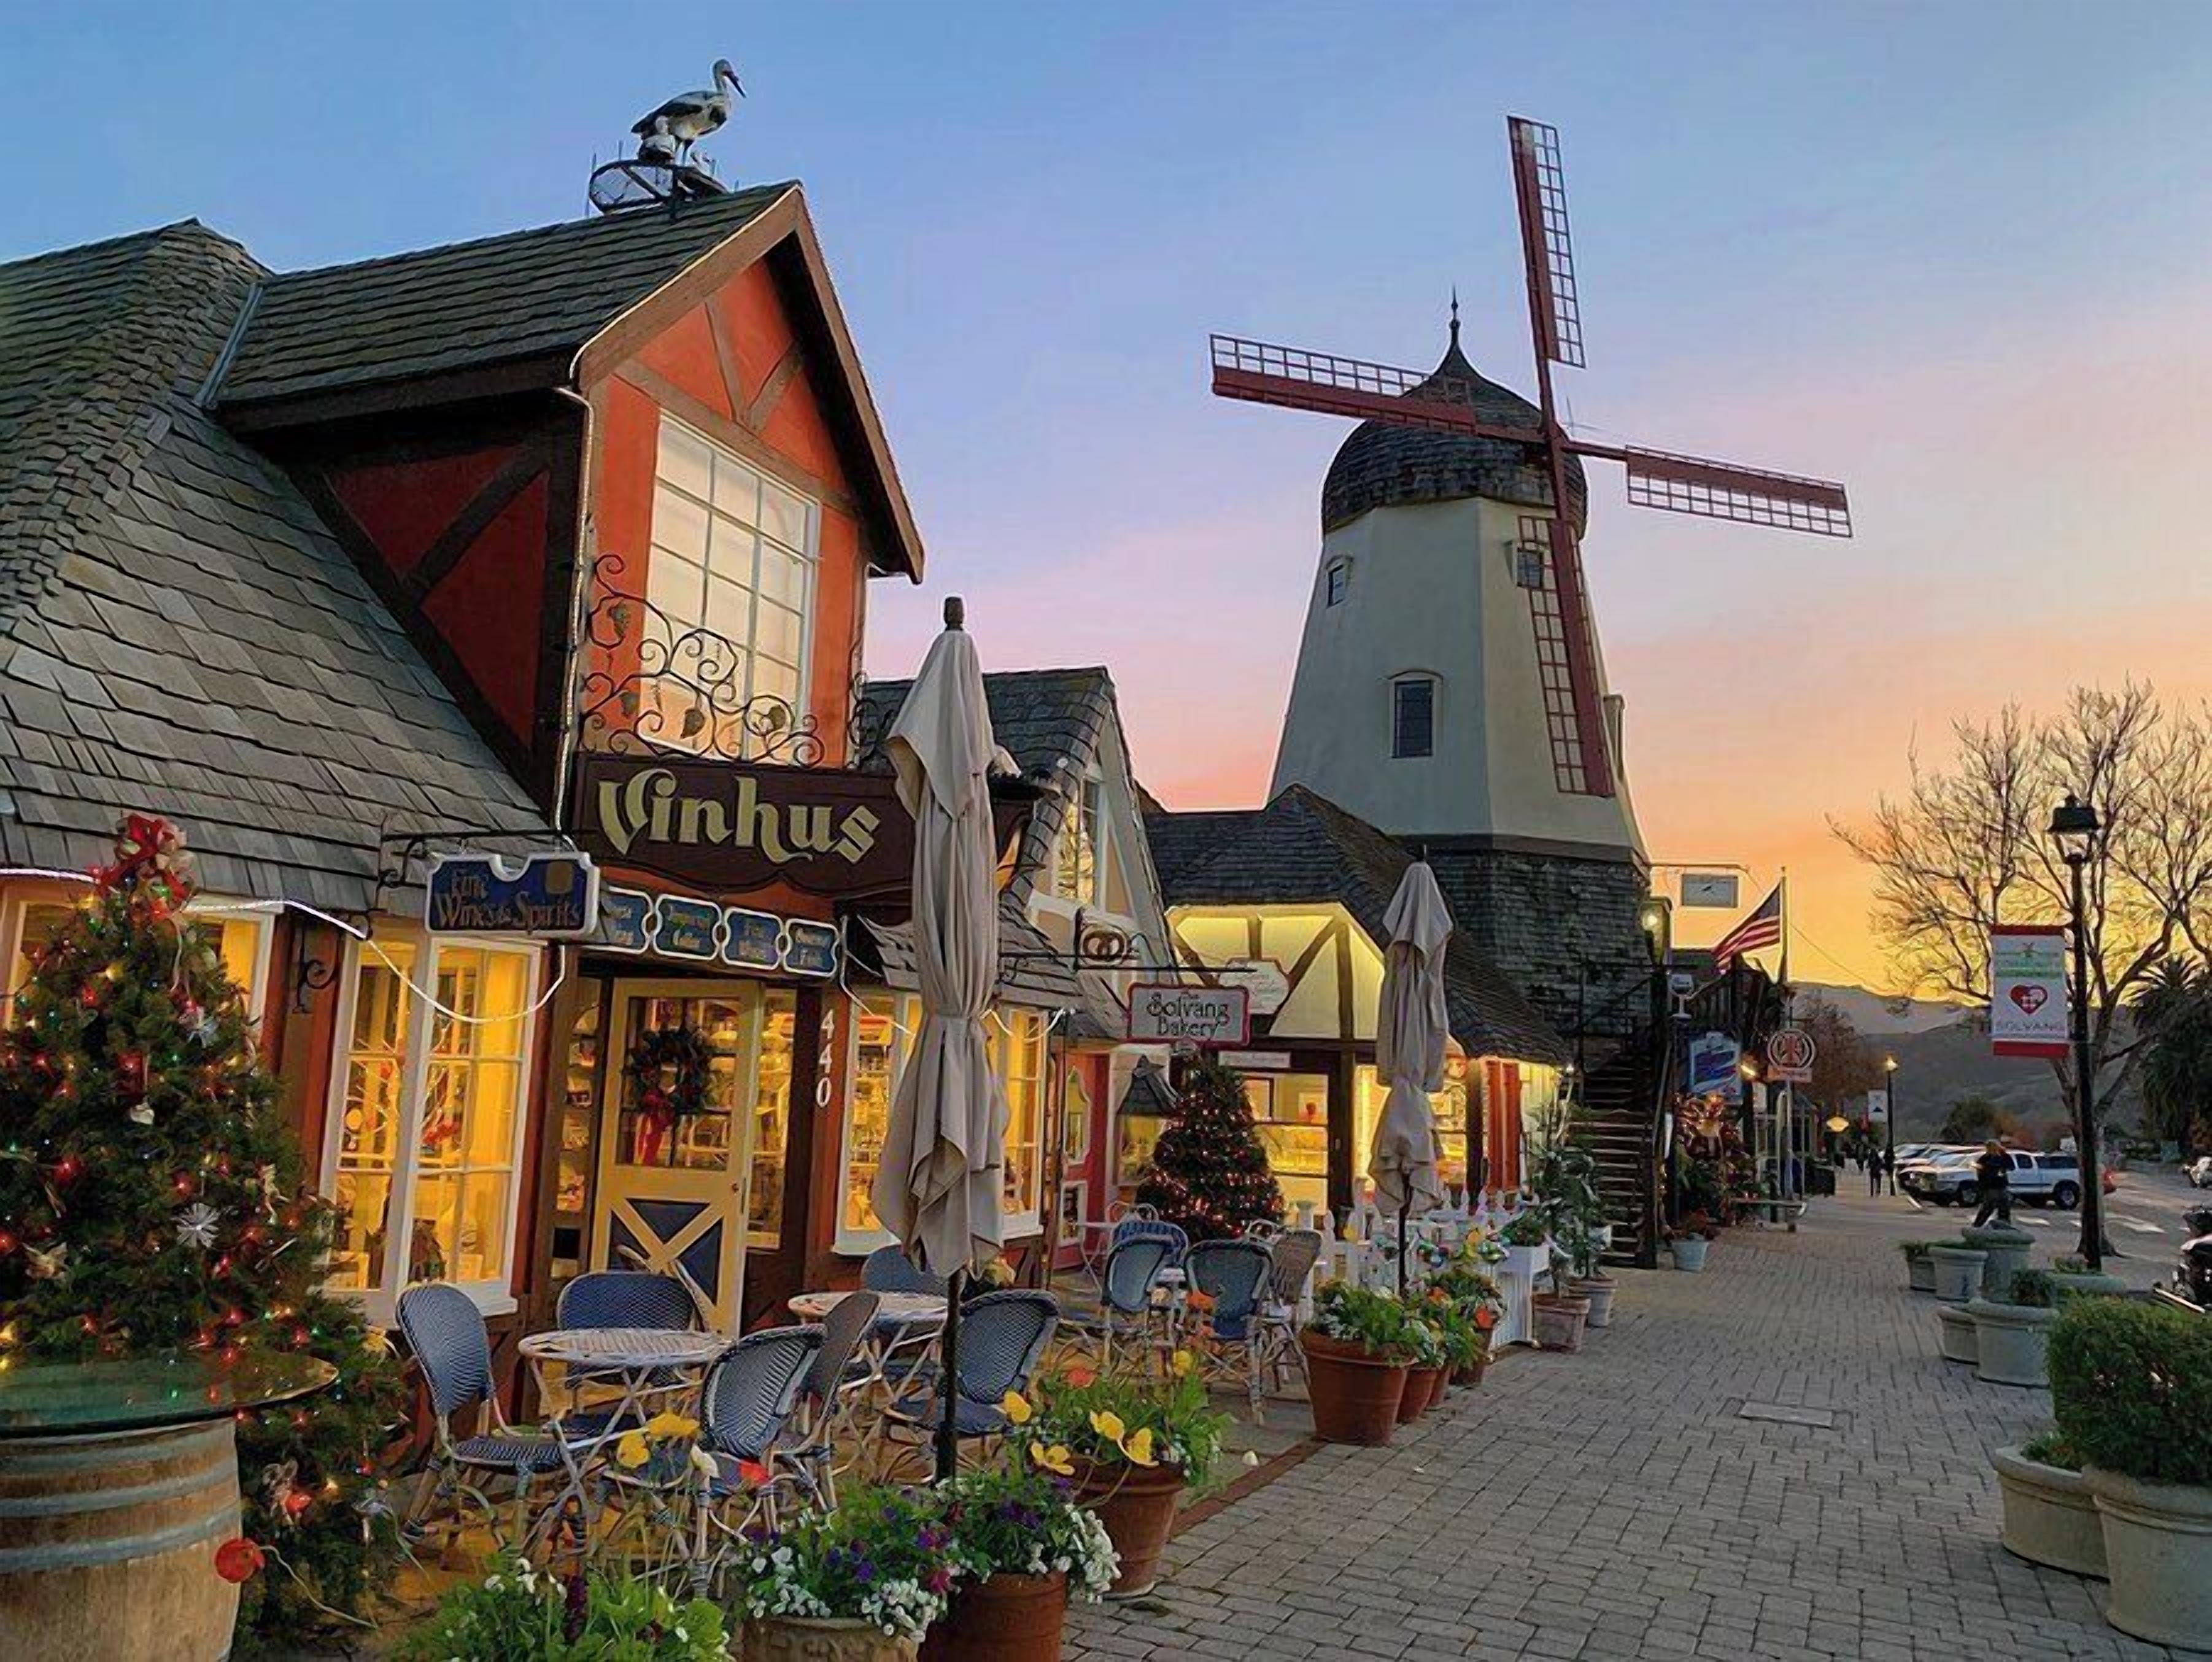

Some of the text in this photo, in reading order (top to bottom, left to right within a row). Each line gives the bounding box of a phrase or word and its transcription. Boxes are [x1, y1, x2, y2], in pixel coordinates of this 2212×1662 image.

[599, 768, 880, 864] Vinhus
[1146, 992, 1231, 1026] Solvang
[1158, 1016, 1218, 1040] Bakery
[816, 1008, 835, 1108] 440
